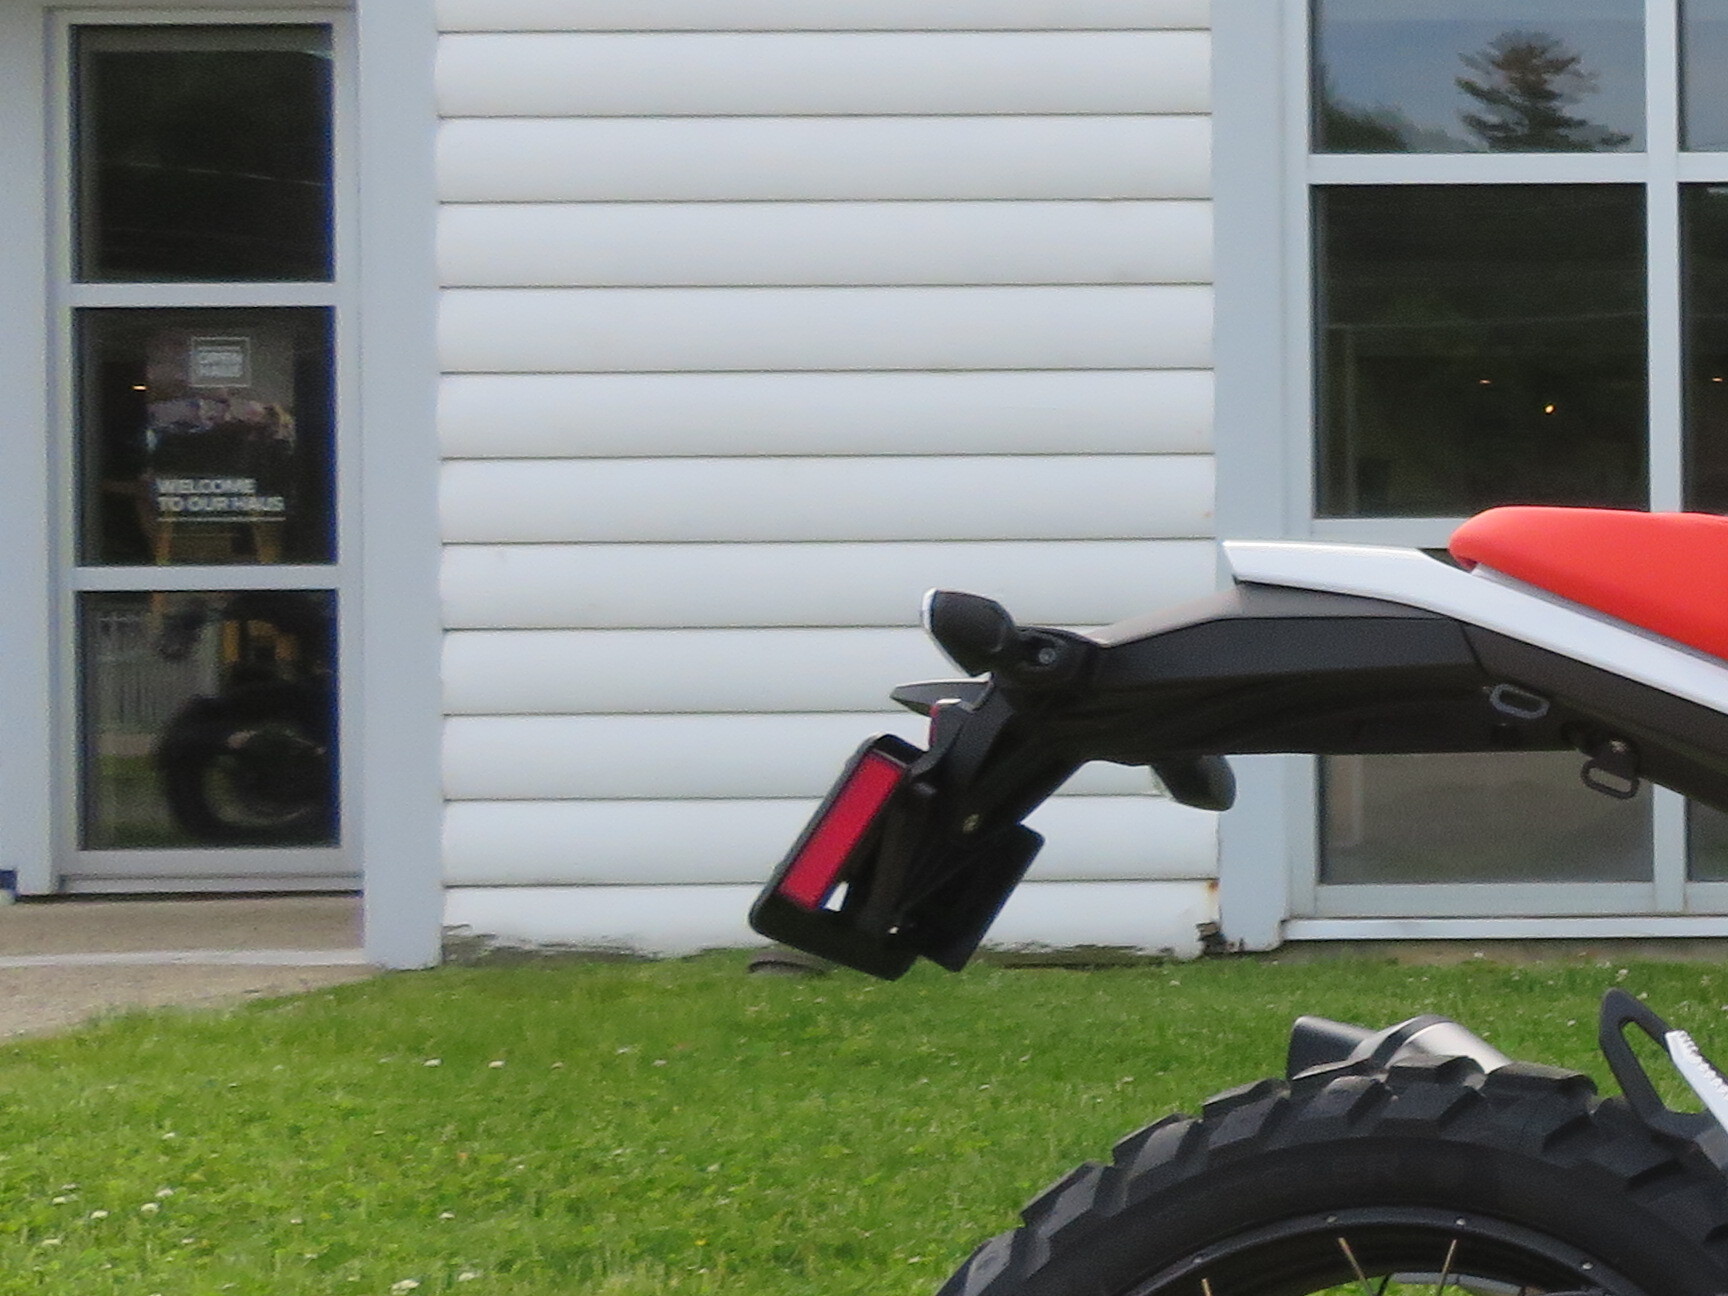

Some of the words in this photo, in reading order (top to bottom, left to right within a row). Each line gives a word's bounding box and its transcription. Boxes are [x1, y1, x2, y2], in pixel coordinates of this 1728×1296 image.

[156, 478, 257, 493] WELCOME
[157, 496, 184, 511] TO
[187, 496, 229, 511] OUR
